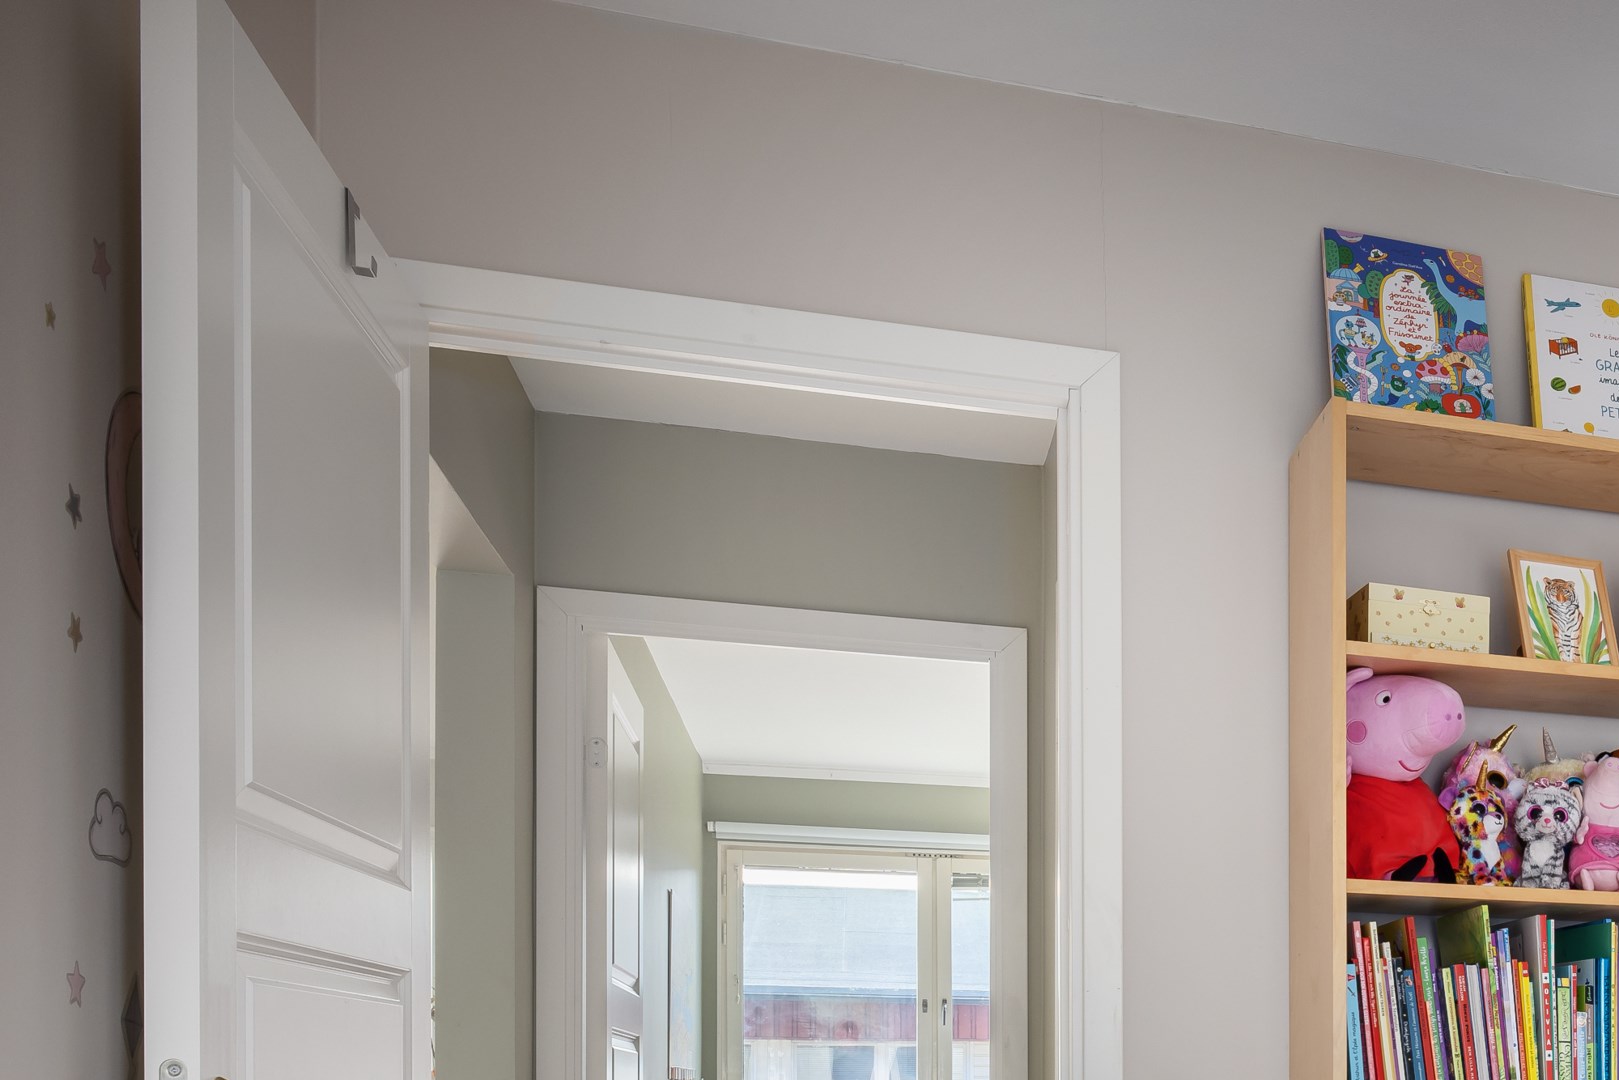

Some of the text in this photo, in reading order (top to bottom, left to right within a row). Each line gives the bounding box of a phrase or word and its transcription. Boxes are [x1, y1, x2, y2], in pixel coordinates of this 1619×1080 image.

[1389, 292, 1426, 303] journée
[1386, 304, 1432, 316] ordinaire
[1394, 318, 1428, 331] Zéphyr
[1609, 348, 1619, 358] Le
